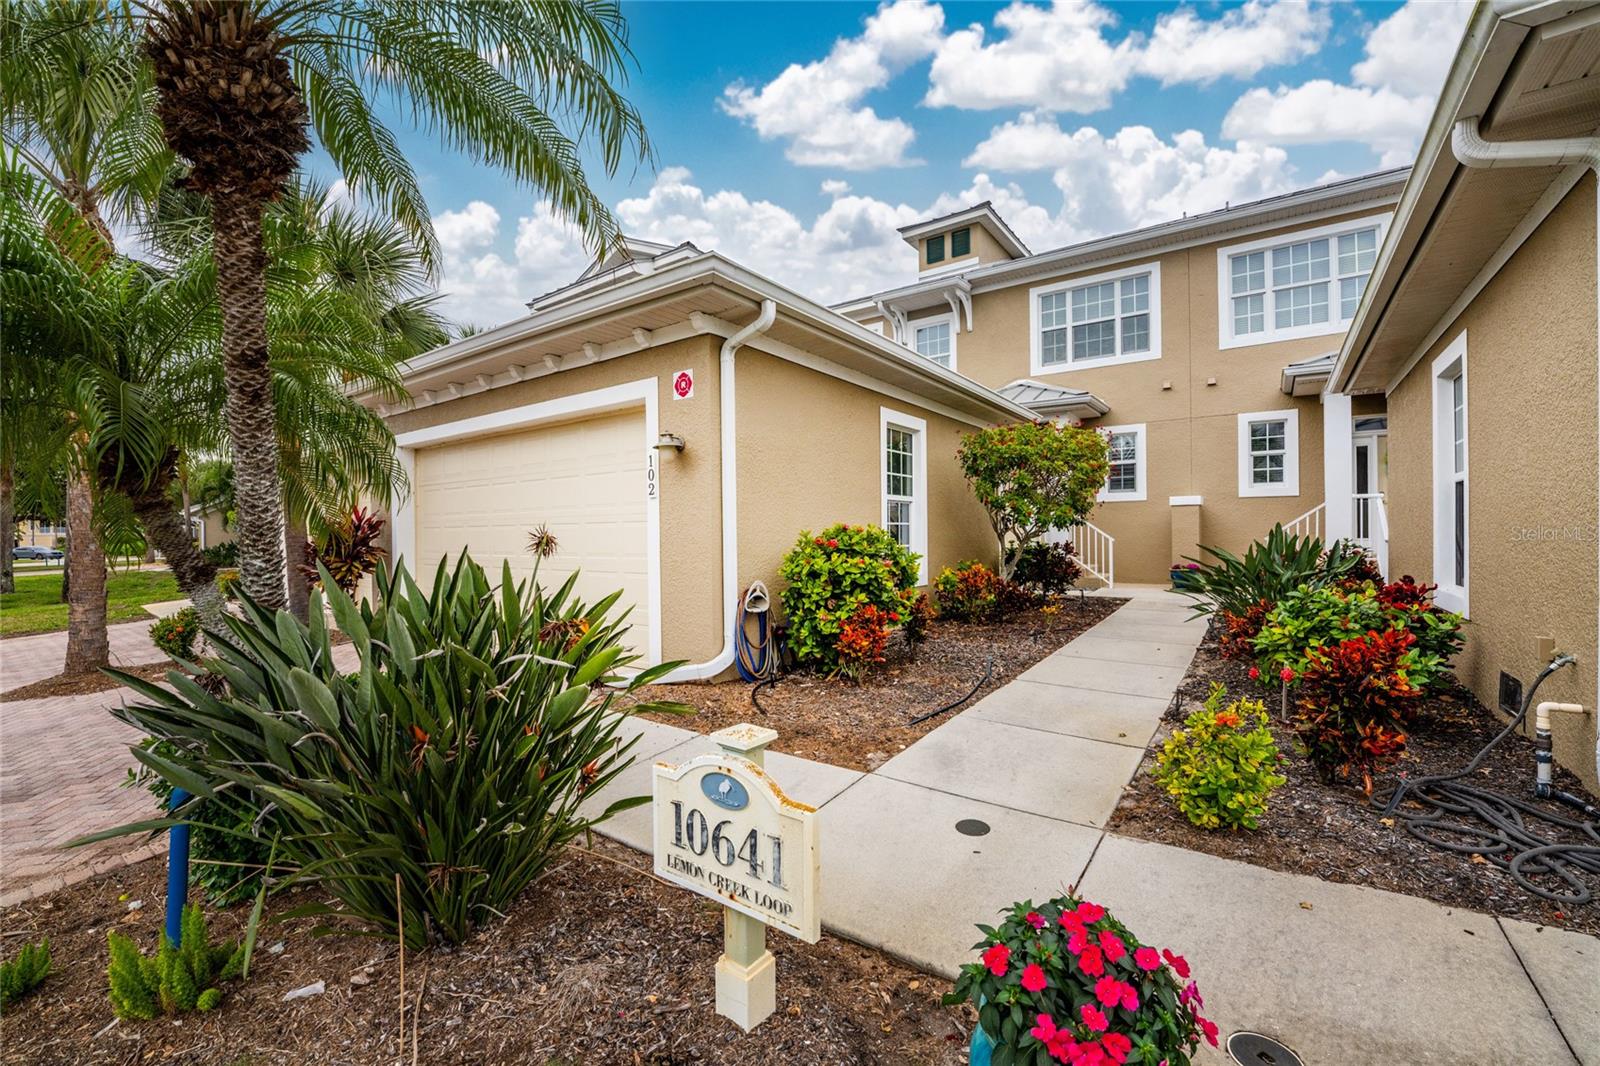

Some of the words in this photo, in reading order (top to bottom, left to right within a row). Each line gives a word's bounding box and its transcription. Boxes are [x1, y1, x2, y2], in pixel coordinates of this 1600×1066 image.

[671, 800, 789, 891] 10641
[667, 854, 704, 880] LEMON
[709, 872, 751, 901] CREEK
[755, 891, 792, 916] LOOP
